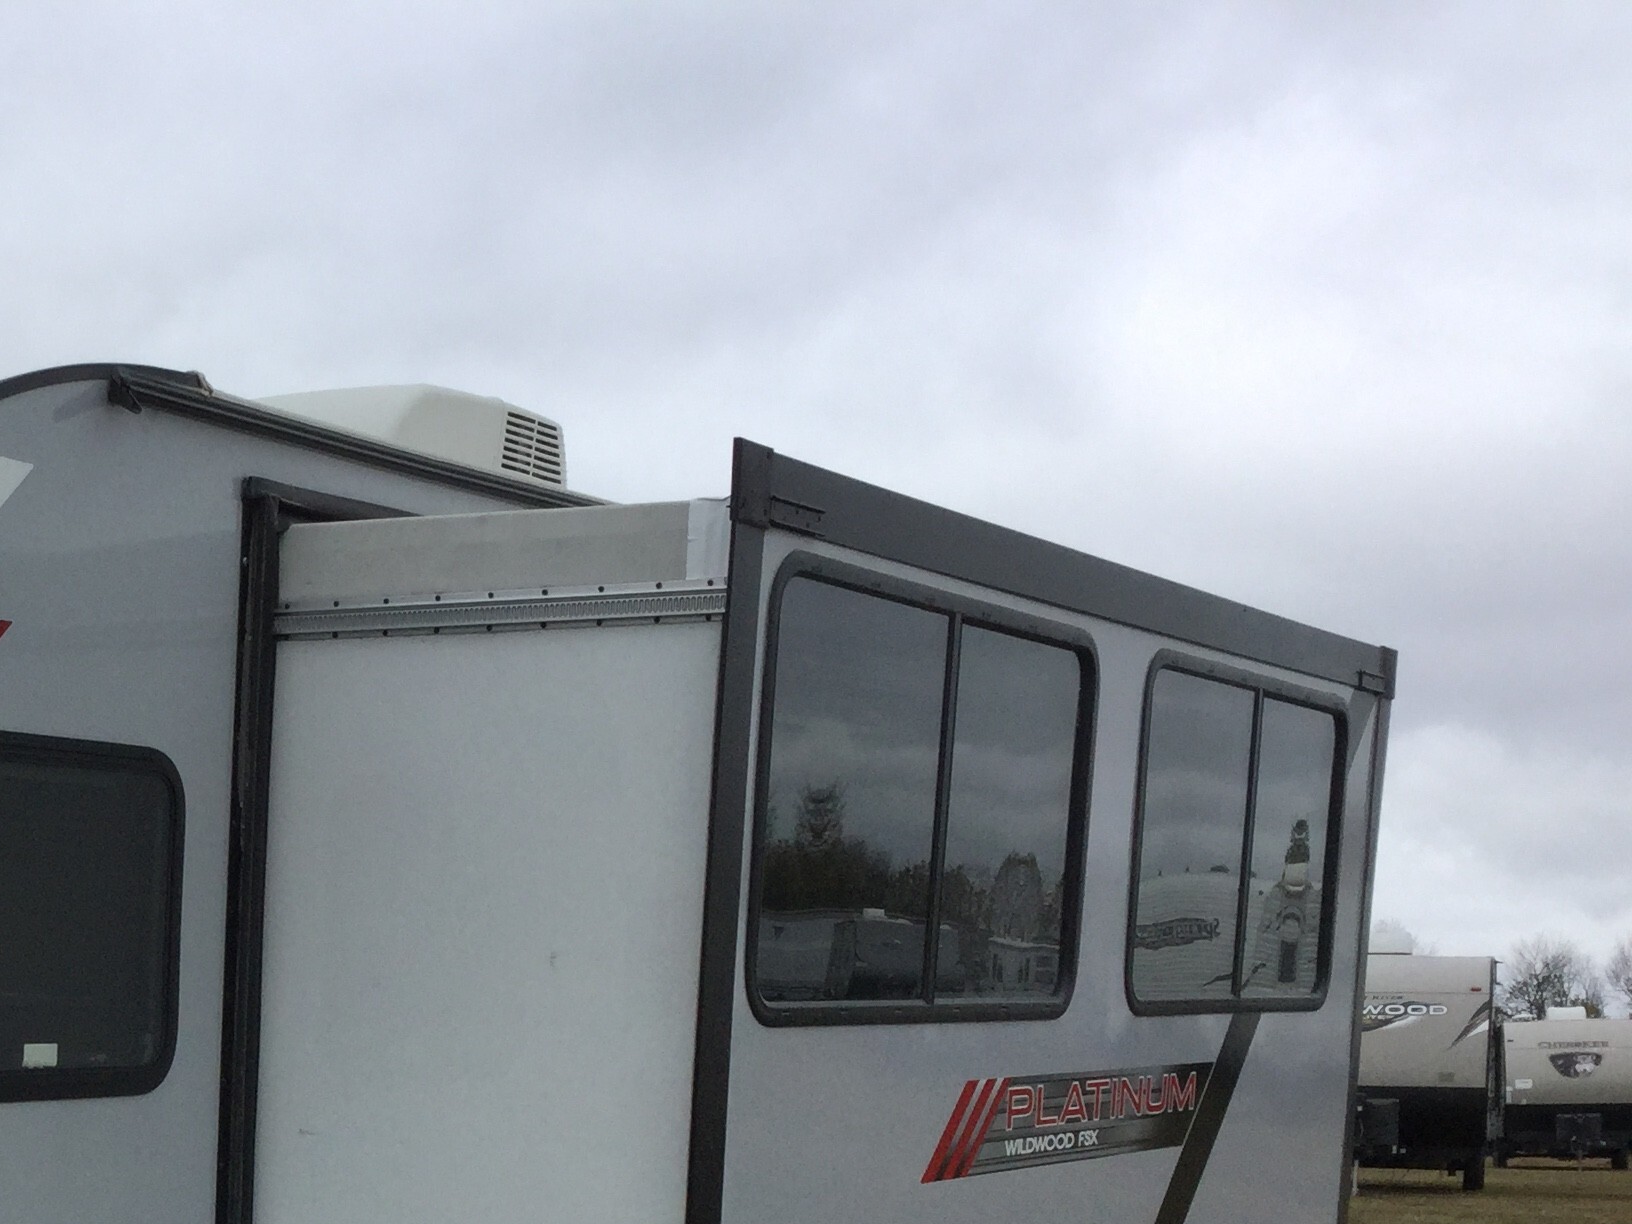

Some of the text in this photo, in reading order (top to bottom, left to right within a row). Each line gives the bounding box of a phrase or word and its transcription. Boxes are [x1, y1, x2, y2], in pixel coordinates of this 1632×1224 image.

[1005, 1071, 1198, 1132] PLATINUM
[1004, 1129, 1099, 1157] WILDWOOD FSX
